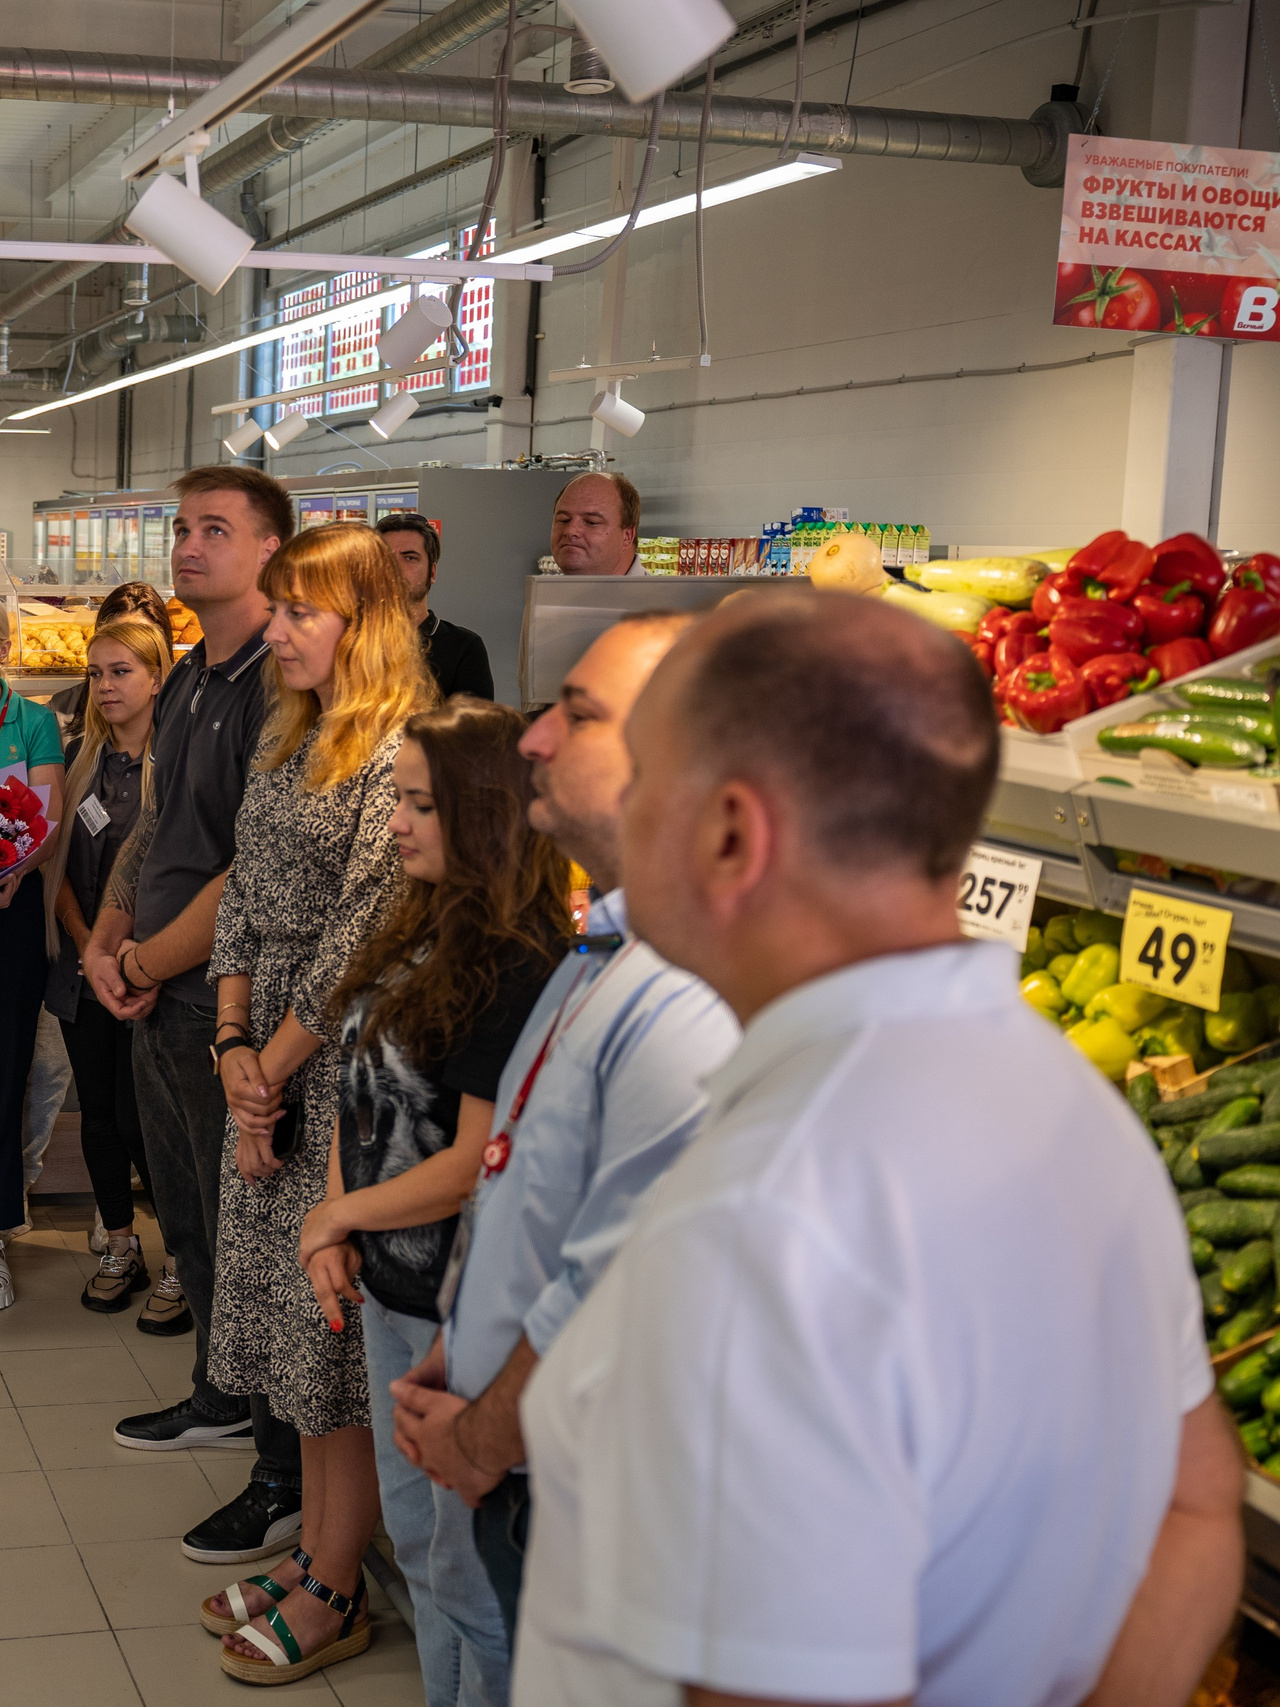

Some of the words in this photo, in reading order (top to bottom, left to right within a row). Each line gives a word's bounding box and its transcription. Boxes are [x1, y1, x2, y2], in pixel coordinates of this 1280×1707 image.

[1085, 154, 1163, 171] УВАЖАЕМЫЕ
[1166, 162, 1249, 178] ПОКУПАТЕЛИ!
[1083, 175, 1176, 200] ФРУКТЫ
[1182, 185, 1196, 202] И
[1081, 201, 1266, 232] ВЗВЕШИВАЮТСЯ
[1079, 226, 1110, 245] НА
[1115, 230, 1202, 252] КАССАХ
[957, 872, 1016, 919] 257
[1138, 926, 1196, 985] 49
[1203, 942, 1216, 955] 99
